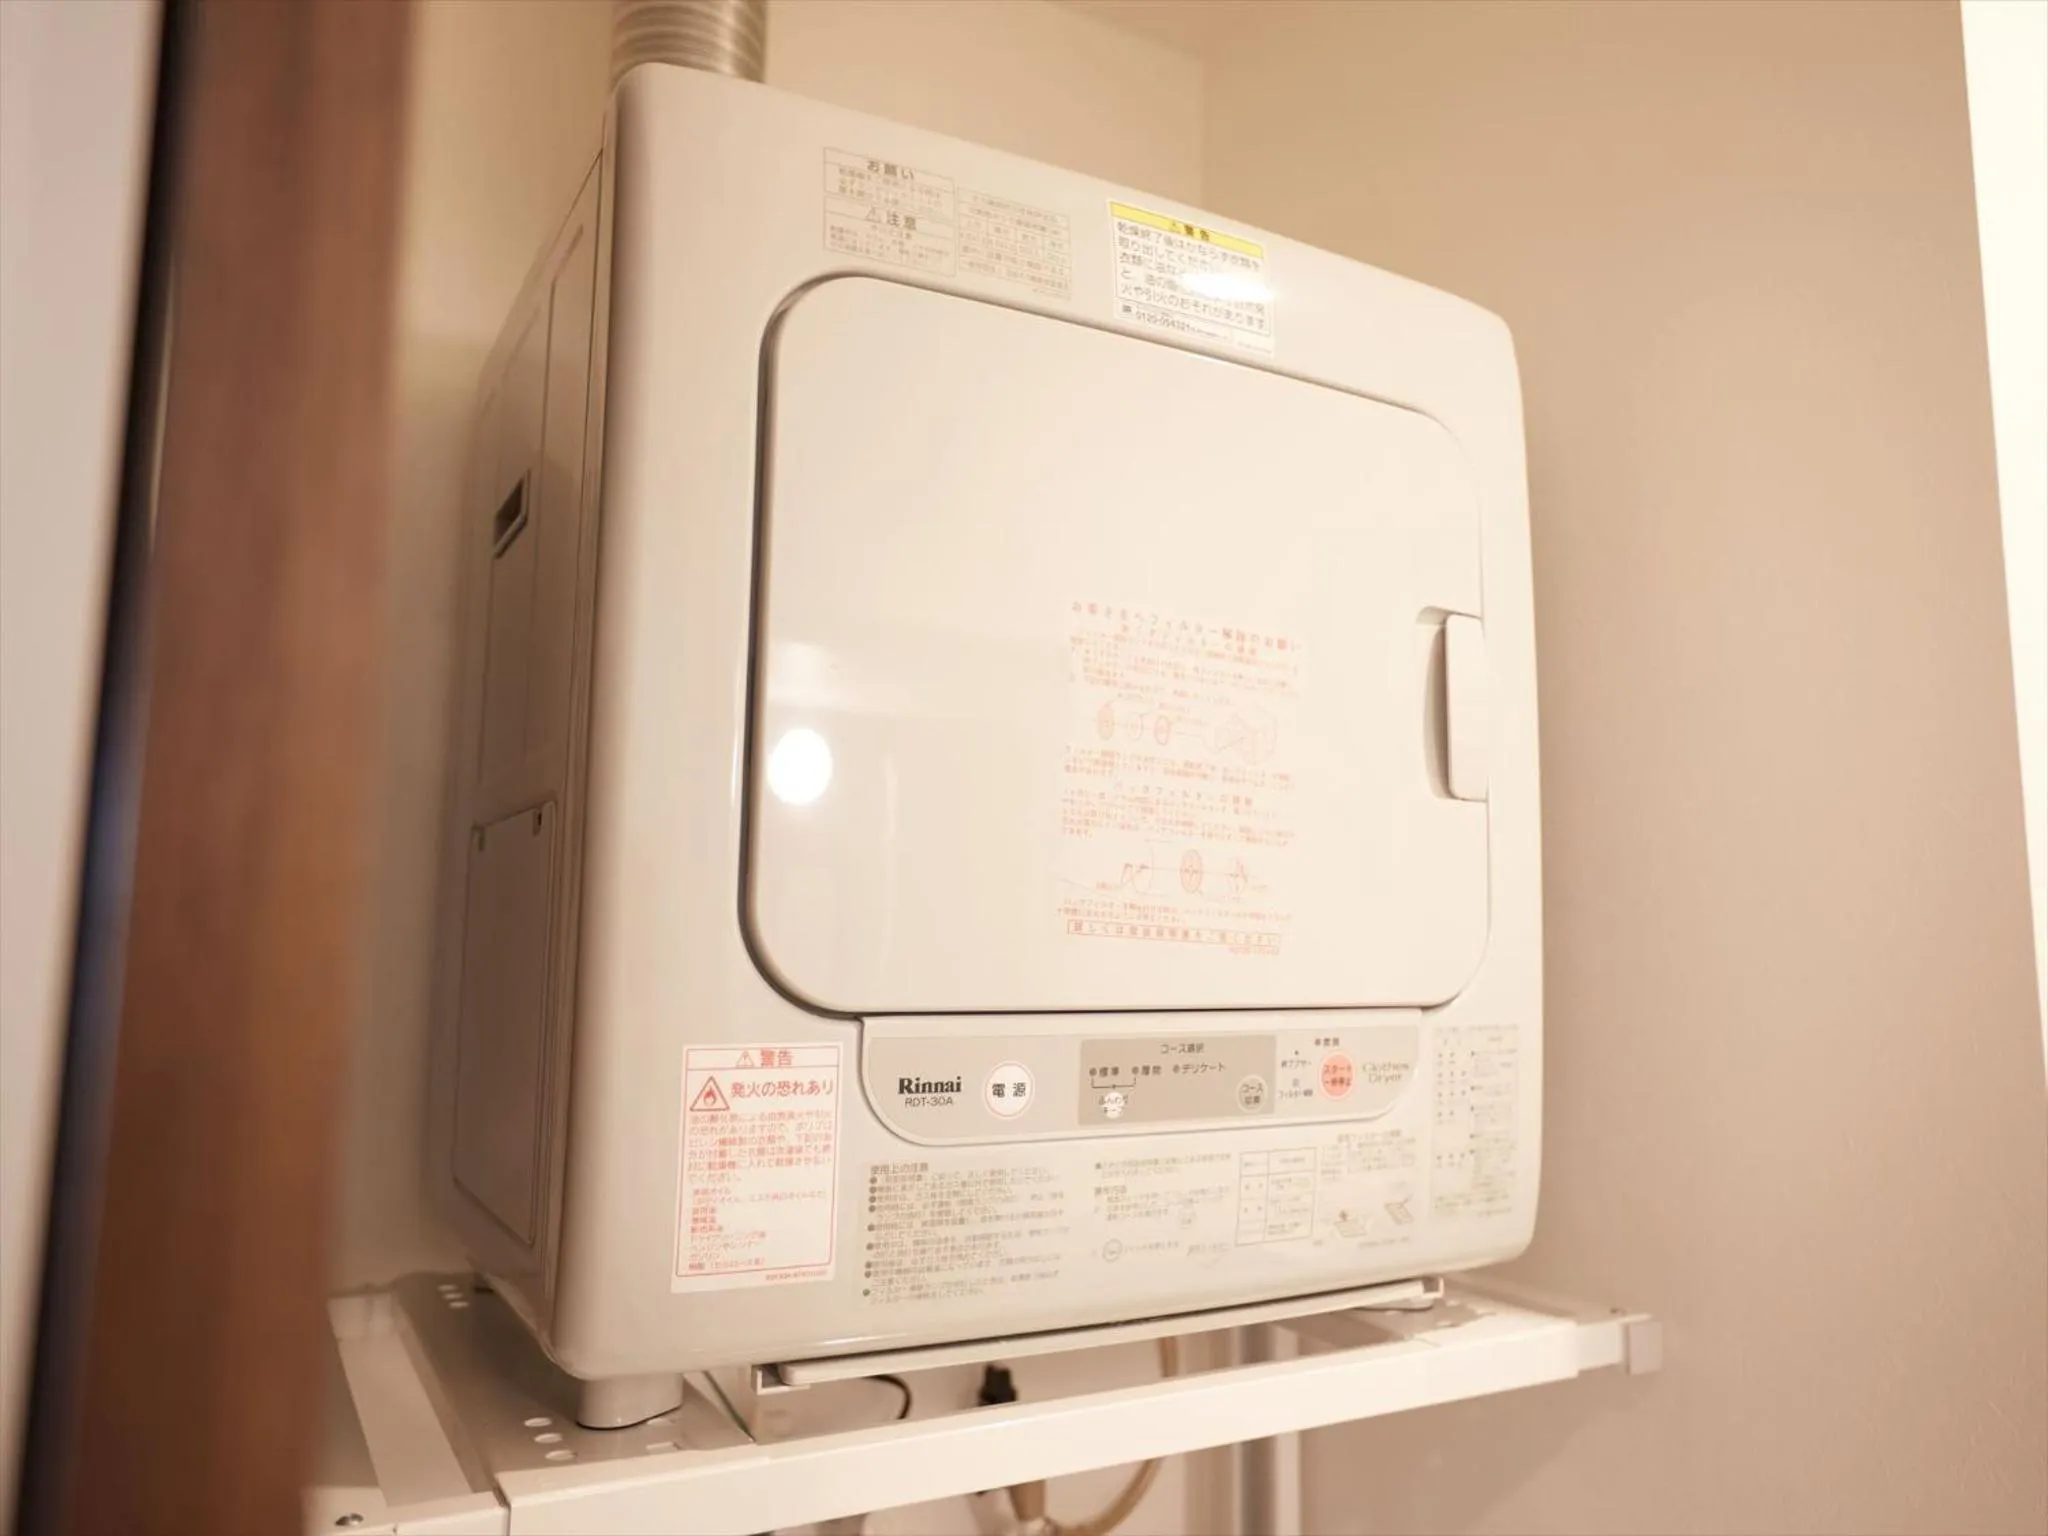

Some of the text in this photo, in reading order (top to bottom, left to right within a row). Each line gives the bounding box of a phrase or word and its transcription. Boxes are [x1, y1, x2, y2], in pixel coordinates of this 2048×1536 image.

[867, 159, 914, 181] お願い
[887, 210, 917, 231] 注意
[1184, 224, 1210, 242] 警告
[761, 1049, 793, 1067] 警告
[1182, 1062, 1225, 1075] デリケート
[731, 1078, 833, 1098] 発火の恐れあり
[898, 1075, 962, 1095] Rinnai
[992, 1082, 1026, 1099] 電源
[904, 1096, 954, 1107] RDT-30A
